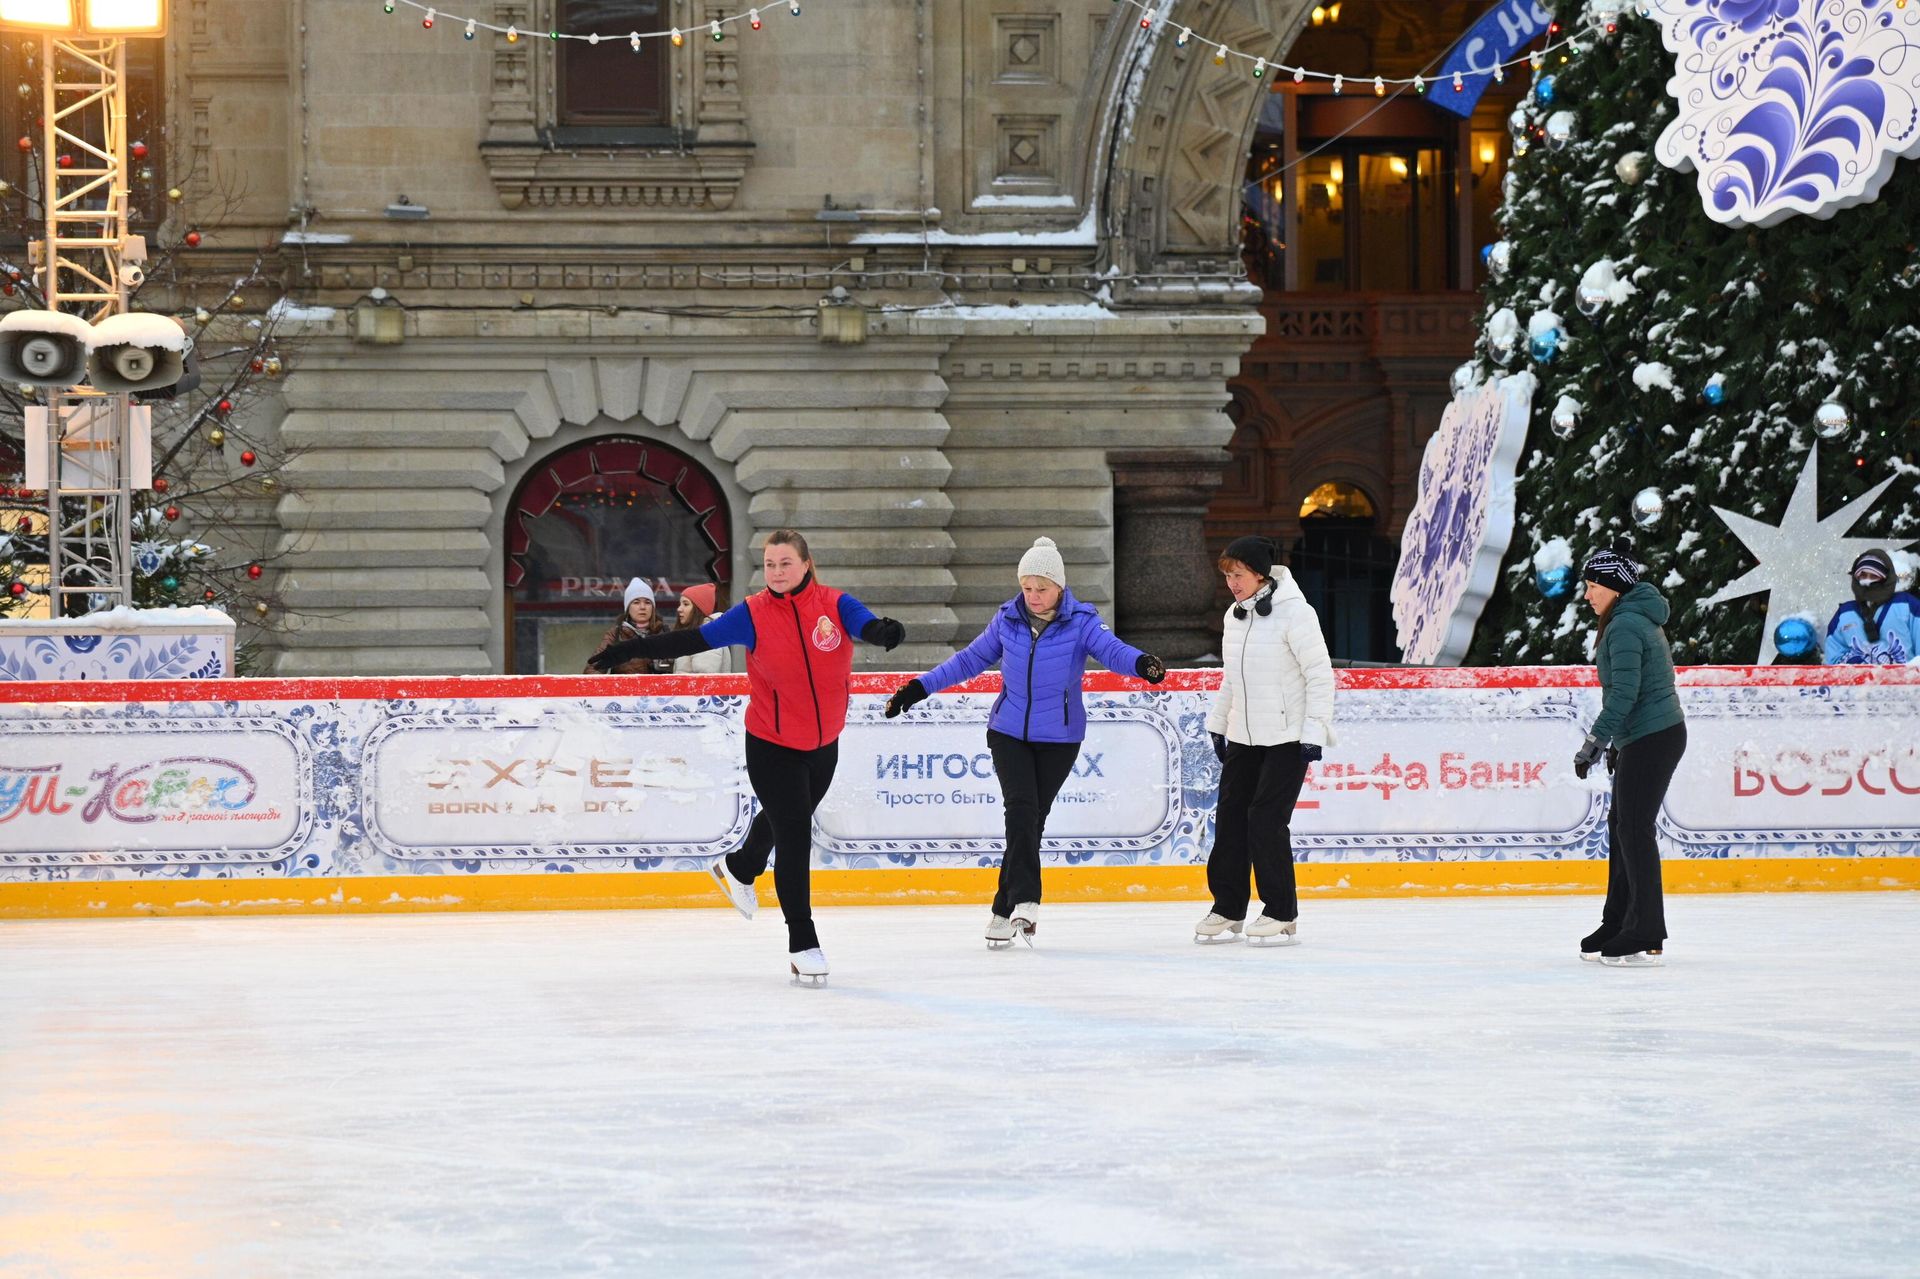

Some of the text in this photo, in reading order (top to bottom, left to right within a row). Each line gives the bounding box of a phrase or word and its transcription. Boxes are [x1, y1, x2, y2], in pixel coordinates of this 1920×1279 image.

[561, 576, 675, 597] PRAA
[876, 753, 1105, 779] ИНГОСХ
[1439, 752, 1547, 790] Банк
[428, 802, 498, 814] BORN
[877, 789, 996, 808] Просто быть
[230, 807, 281, 823] площади
